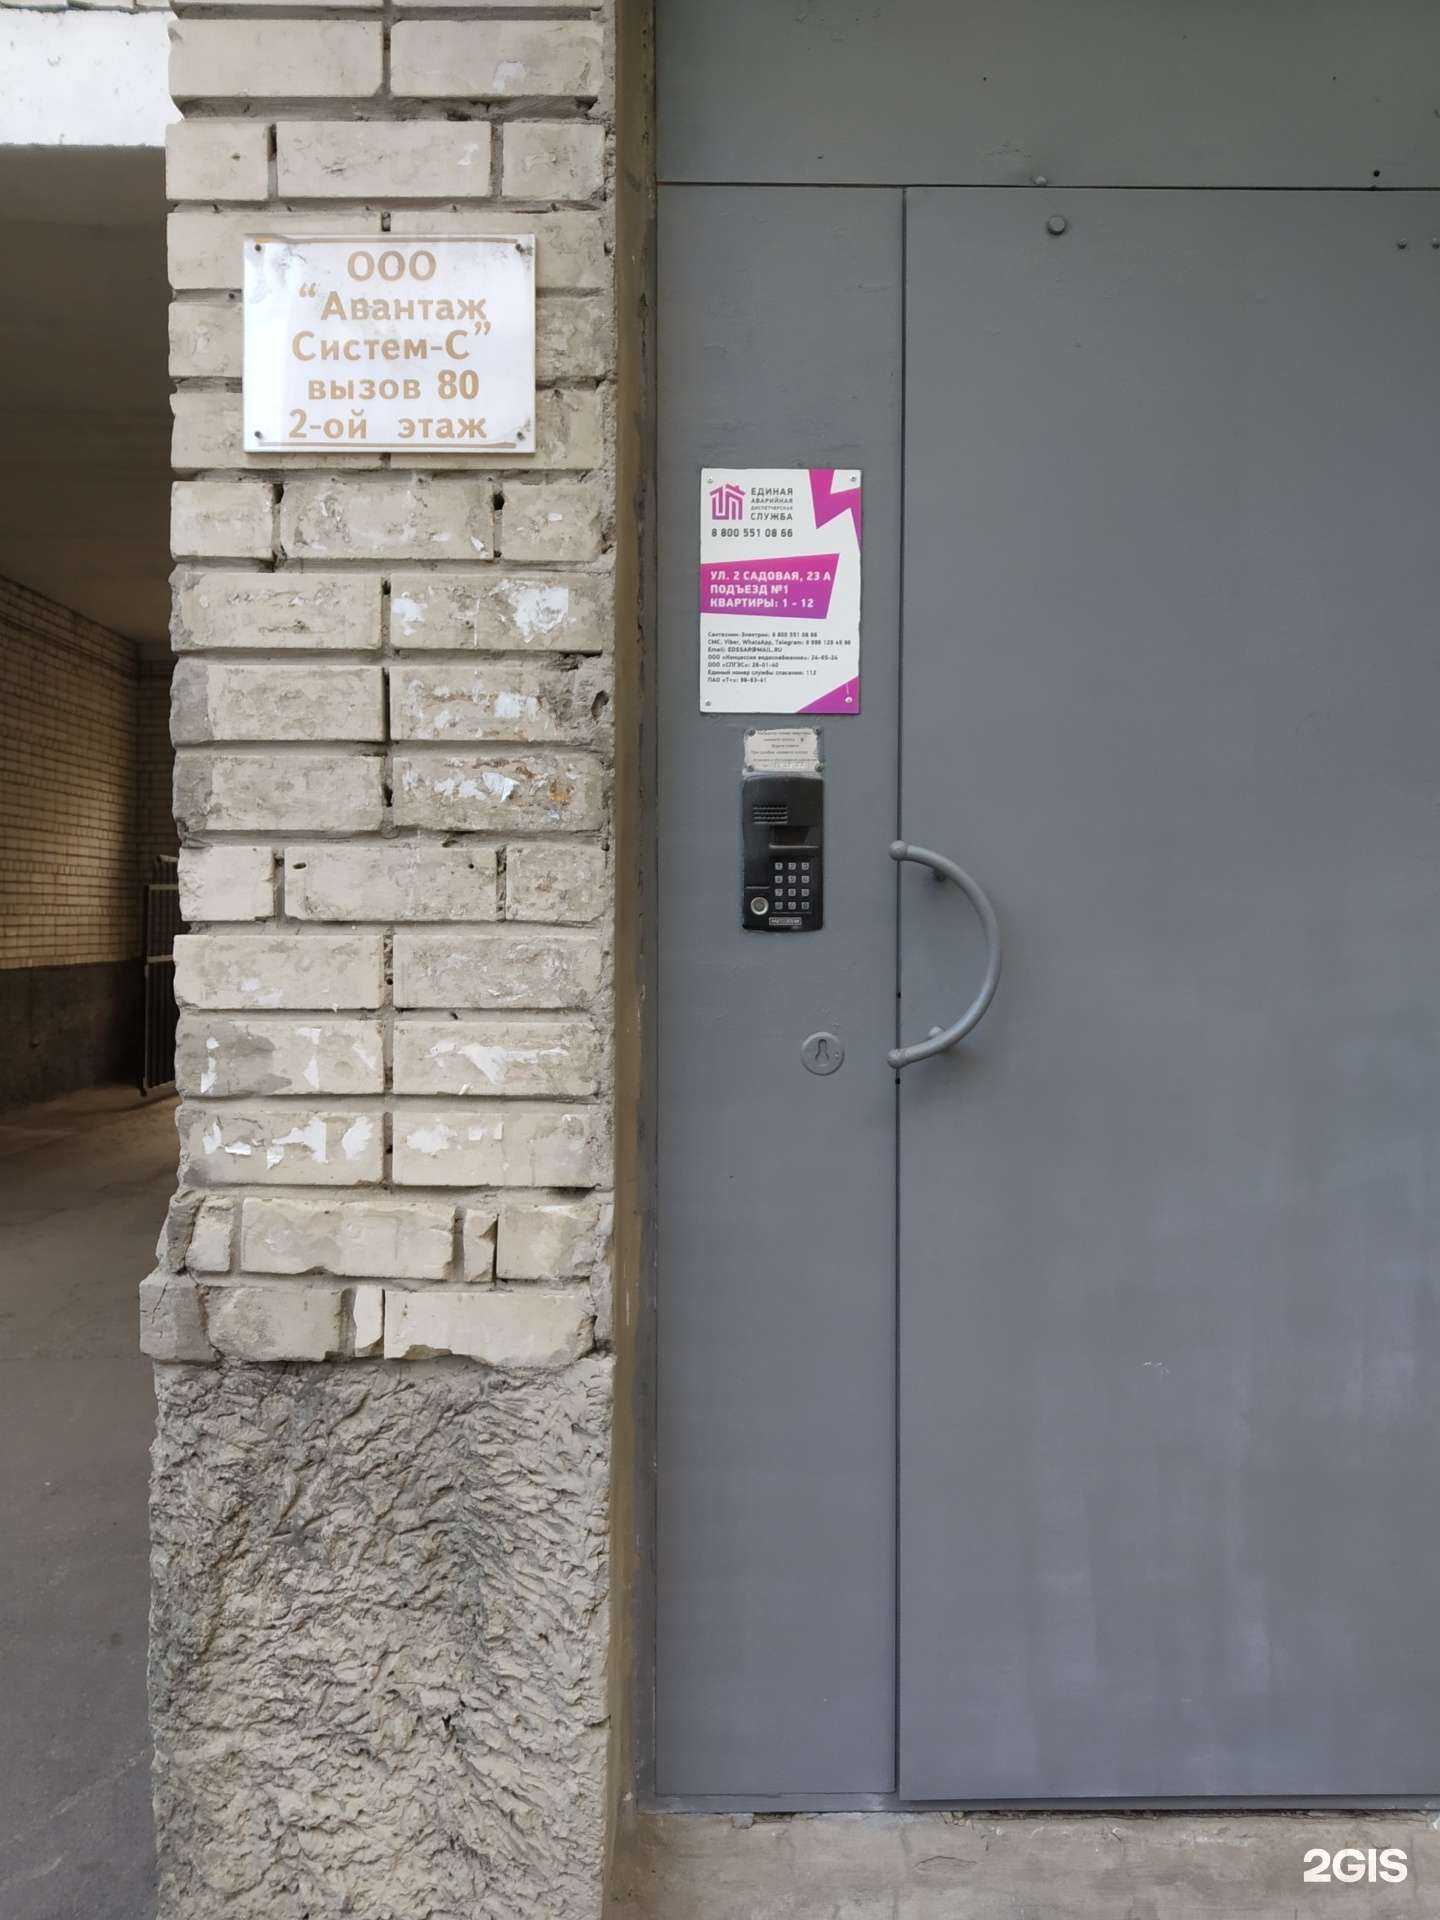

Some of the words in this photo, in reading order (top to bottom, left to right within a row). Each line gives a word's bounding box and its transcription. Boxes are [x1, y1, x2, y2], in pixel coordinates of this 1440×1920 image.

[347, 250, 437, 282] ООО
[307, 378, 422, 401] вызов
[436, 368, 480, 401] 80
[287, 408, 368, 440] 2-ой
[397, 417, 488, 440] этаж
[751, 487, 793, 497] ЕДИНАЯ
[751, 512, 793, 521] СЛУЖБА
[711, 527, 718, 538] 8
[720, 527, 740, 538] 800
[743, 527, 761, 538] 551
[764, 527, 778, 538] 08
[780, 528, 793, 538] 66
[710, 570, 730, 581] УЛ.
[733, 570, 740, 581] 2
[743, 571, 804, 583] САДОВАЯ,
[806, 571, 820, 581] 23
[710, 584, 768, 596] ПОДЪЕЗД
[710, 598, 779, 608] КВАРТИРЫ:
[782, 598, 788, 608] 1
[801, 598, 814, 608] 12
